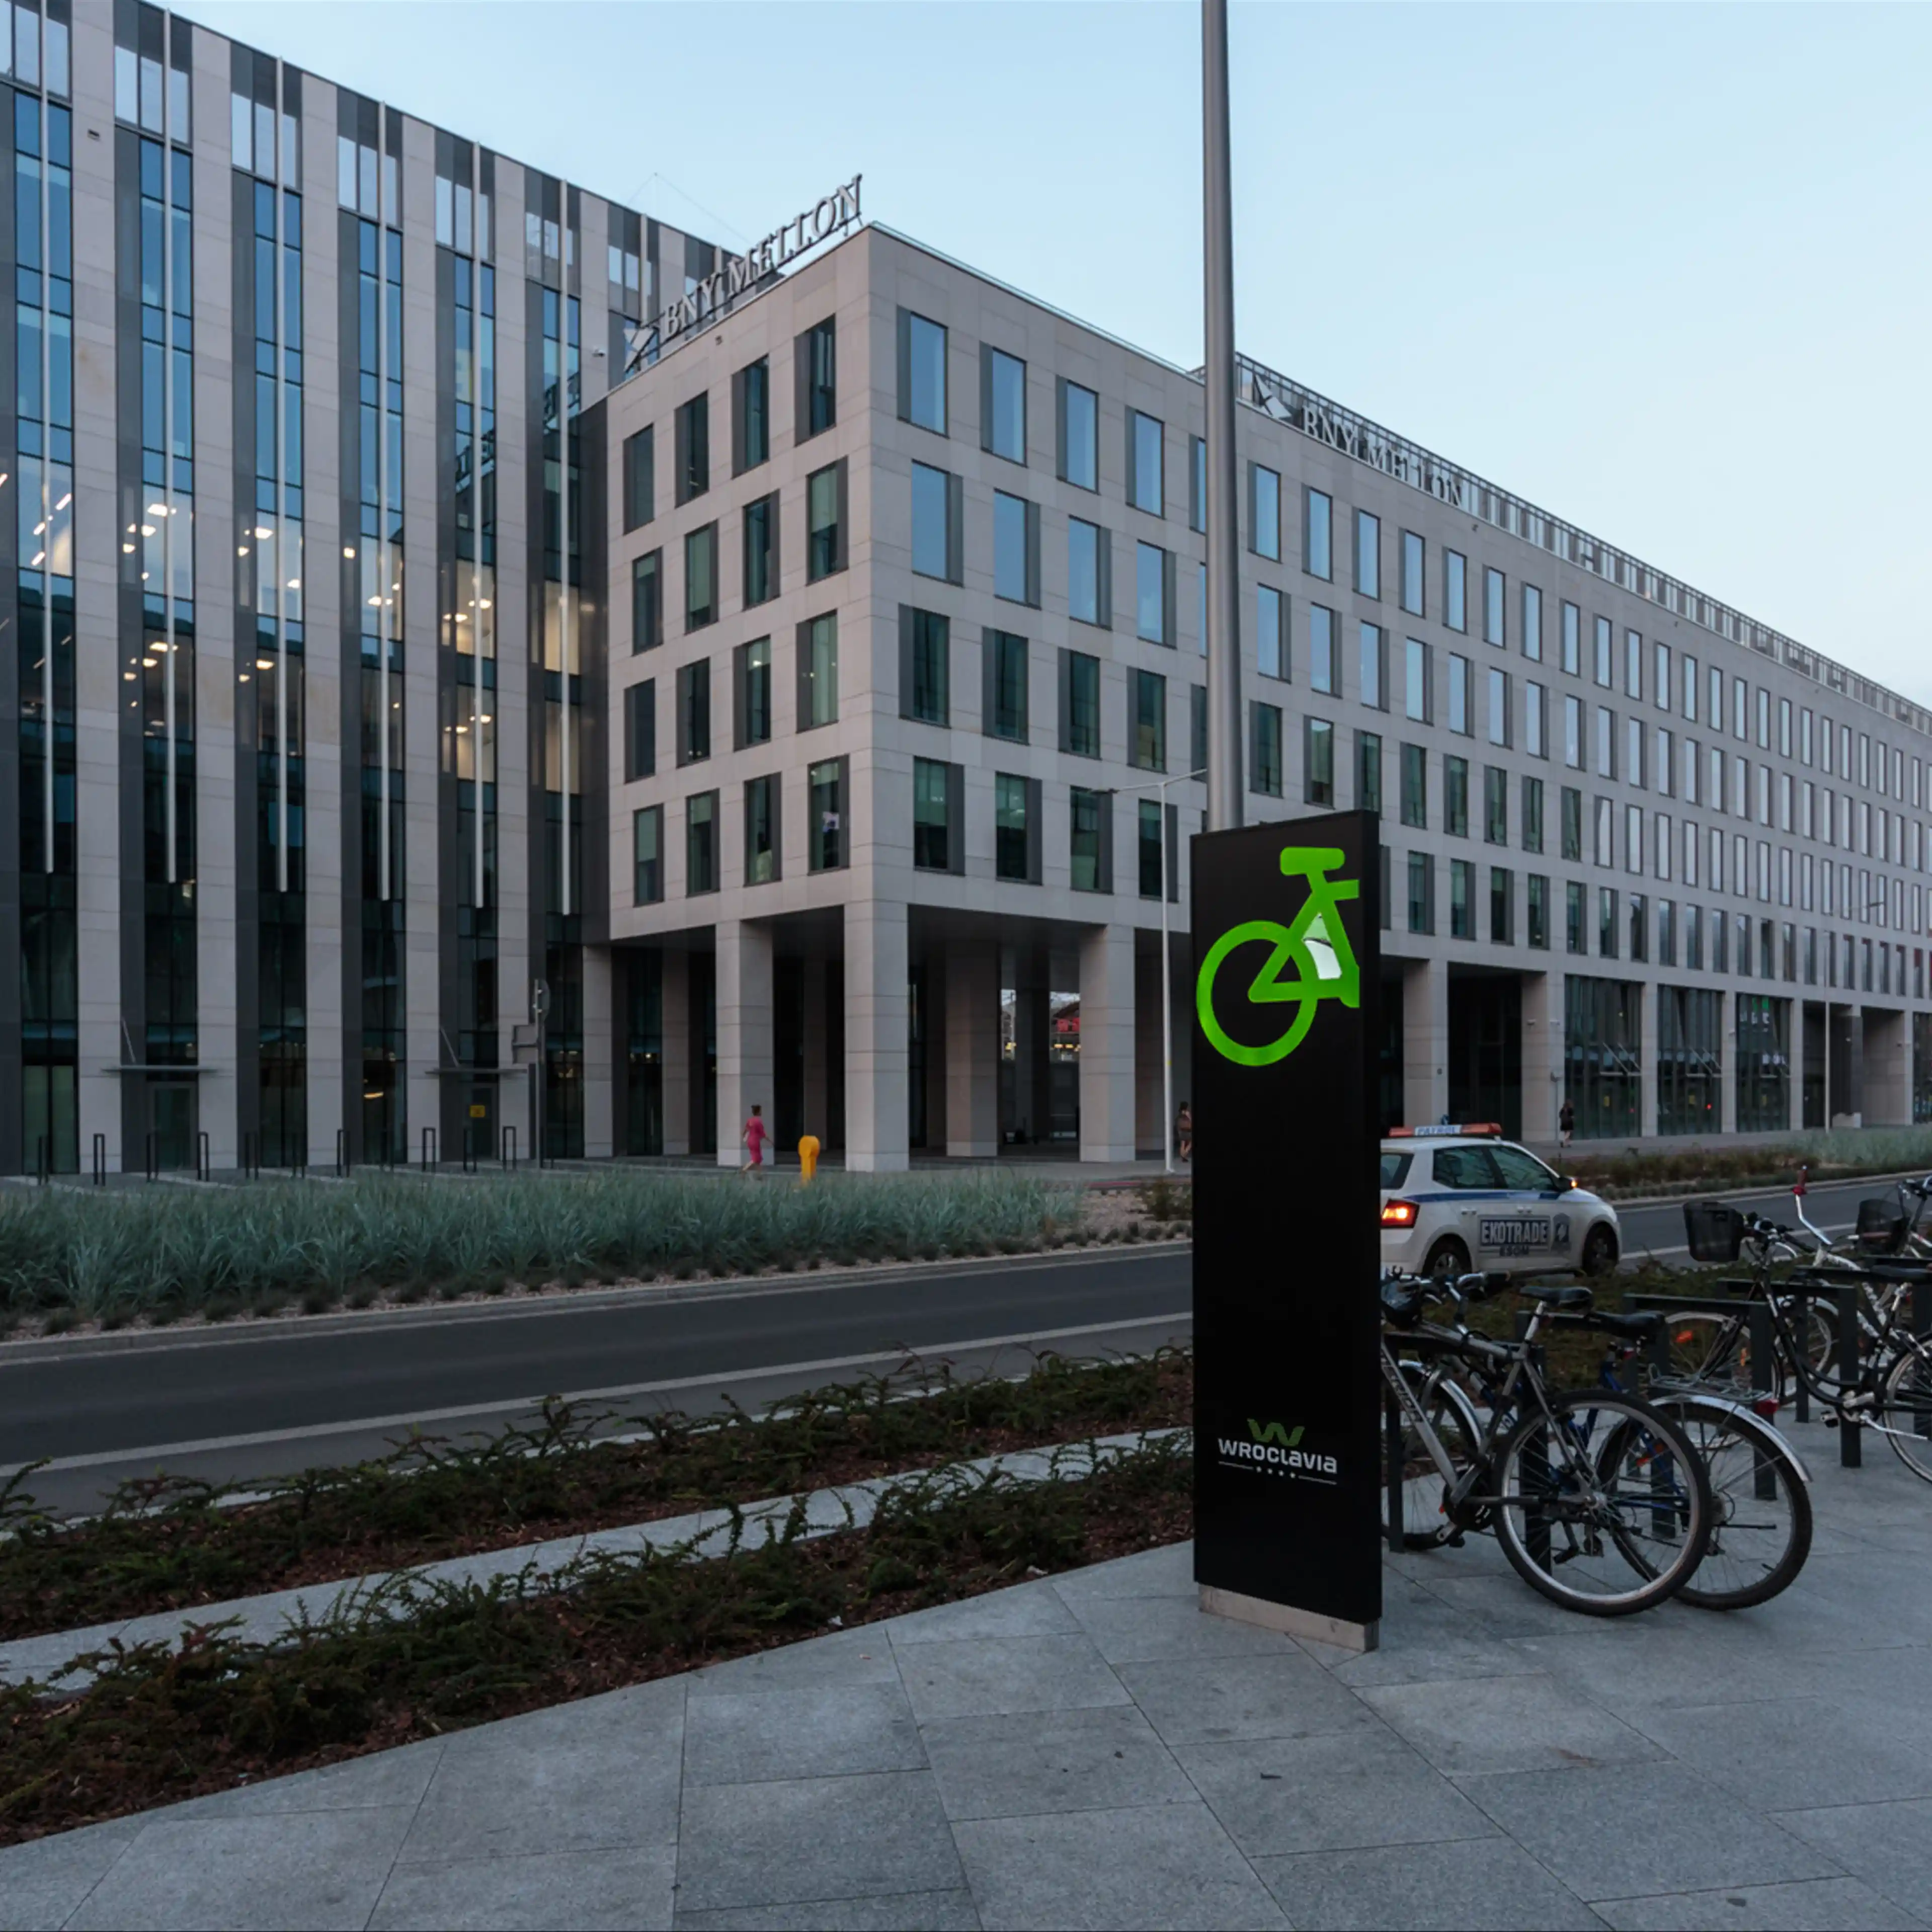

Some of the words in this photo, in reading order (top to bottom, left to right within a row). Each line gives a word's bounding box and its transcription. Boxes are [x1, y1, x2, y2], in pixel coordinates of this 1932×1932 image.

[663, 272, 722, 340] BNY
[728, 174, 862, 297] MELLON
[1303, 405, 1355, 455] BNY
[1481, 1221, 1549, 1244] EKOTRADE
